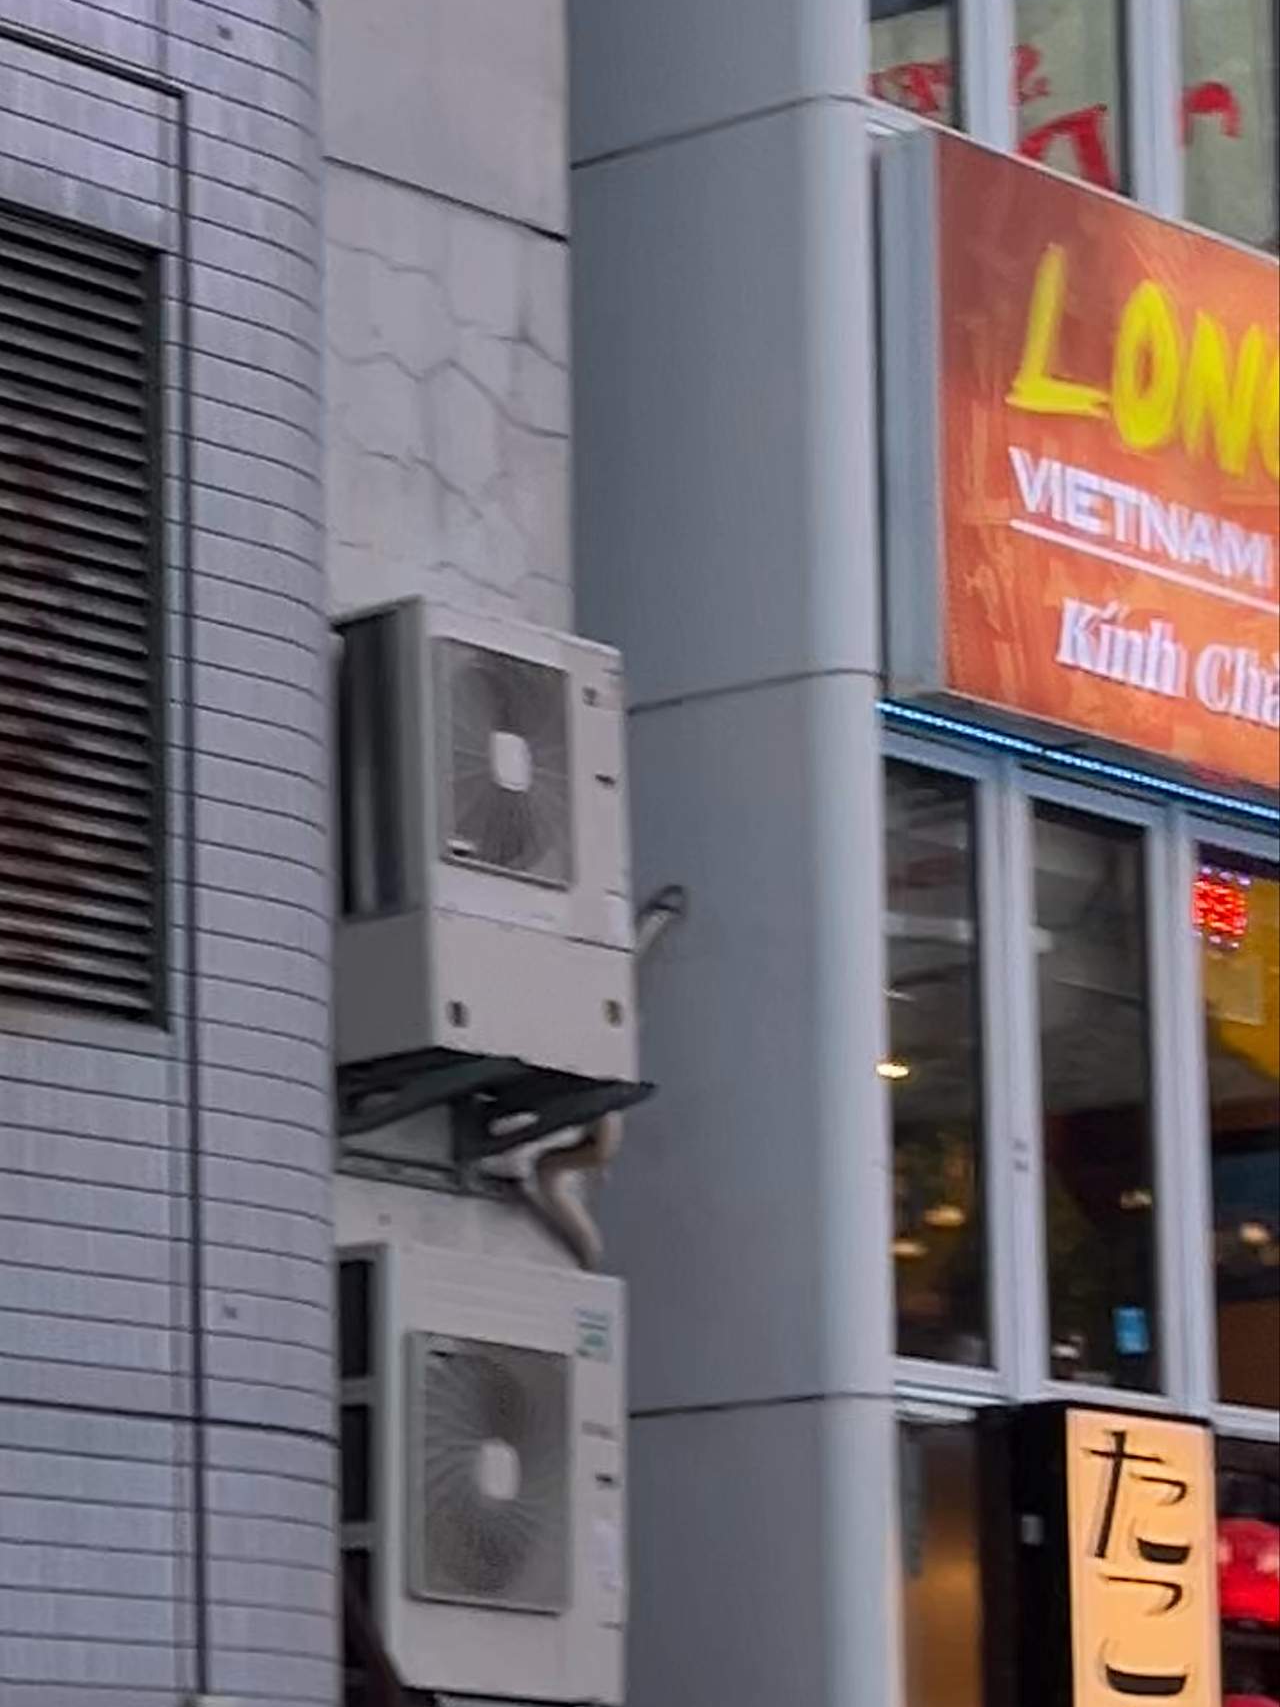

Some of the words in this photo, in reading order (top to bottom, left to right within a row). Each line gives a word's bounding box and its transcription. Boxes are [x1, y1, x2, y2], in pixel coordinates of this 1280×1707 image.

[1005, 242, 1280, 483] LON
[1009, 445, 1276, 591] VIETNAM
[1054, 595, 1189, 699] Kính
